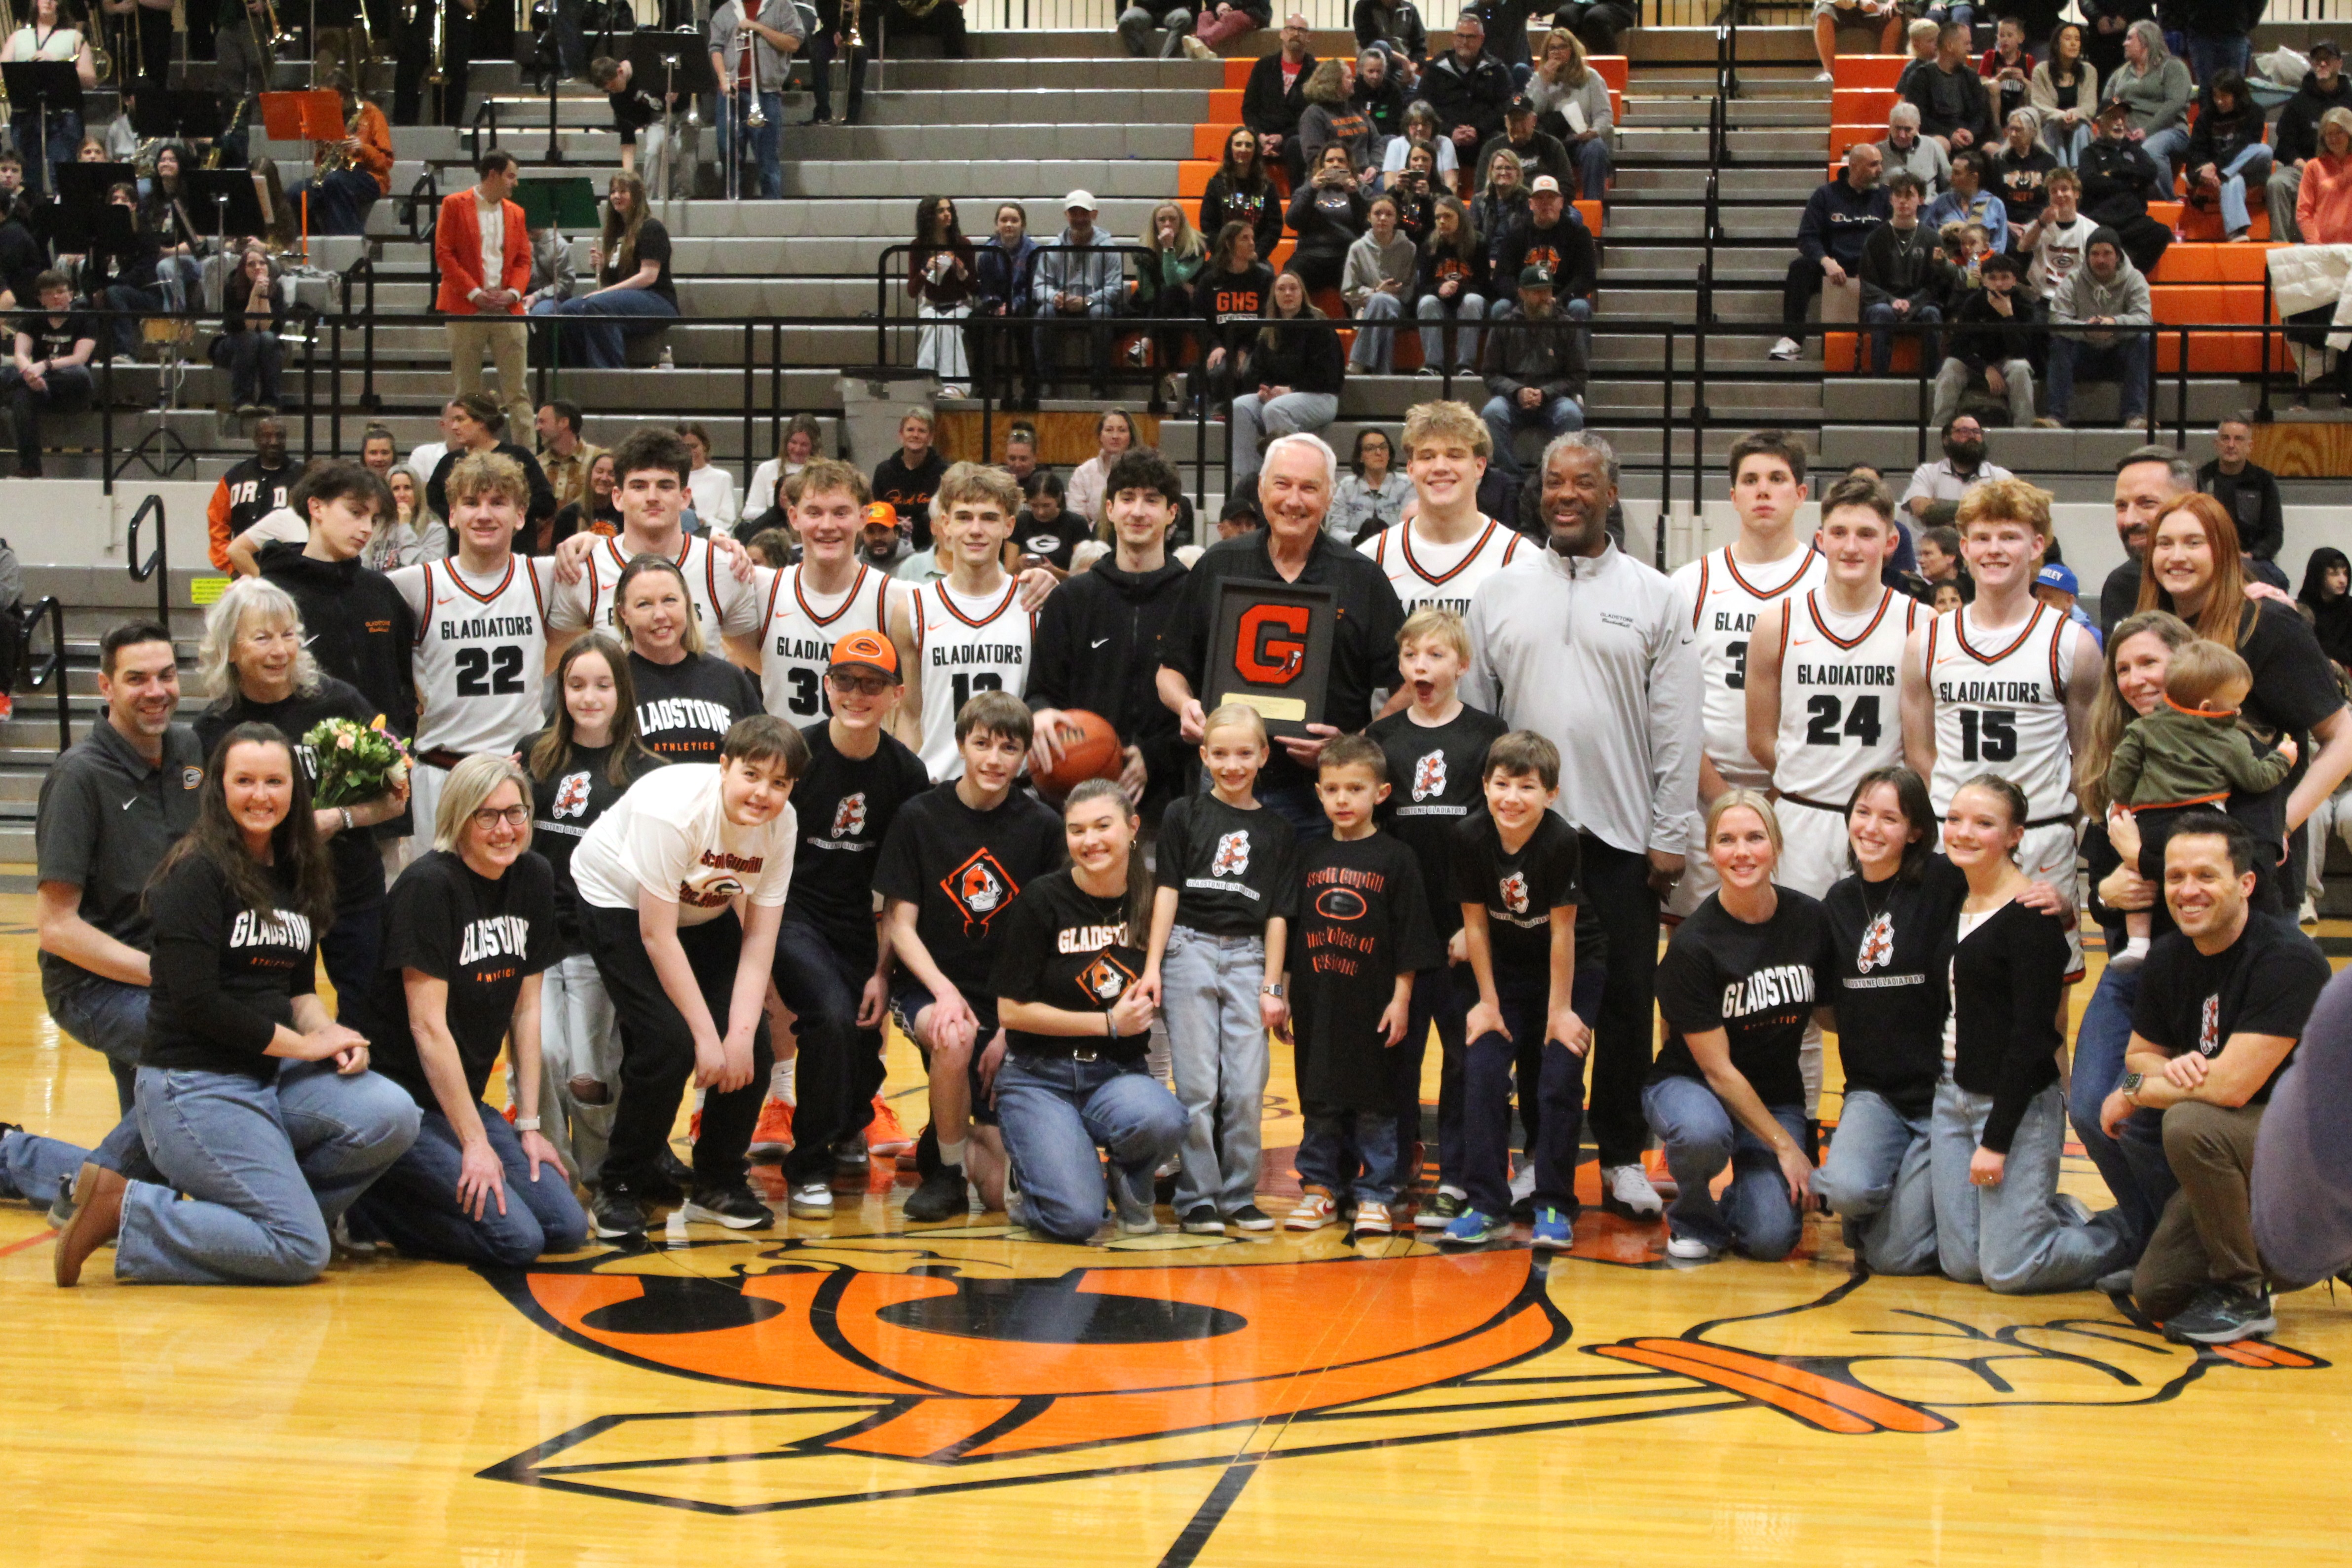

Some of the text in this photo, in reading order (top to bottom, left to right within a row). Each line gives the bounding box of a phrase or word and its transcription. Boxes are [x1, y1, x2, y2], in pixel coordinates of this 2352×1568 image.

[1216, 292, 1258, 311] GHS
[441, 616, 533, 640] GLADIATORS
[1715, 612, 1760, 632] GLAD
[933, 644, 1023, 667] GLADIATORS
[1234, 603, 1310, 686] G
[455, 646, 525, 697] 22
[1798, 664, 1895, 686] GLADIATORS
[1940, 682, 2040, 704] GLADIATORS
[636, 697, 731, 736] LADSTONE
[1807, 695, 1882, 746] 24
[654, 742, 716, 752] ATHLETICS
[1960, 710, 2017, 762] 15
[1427, 805, 1467, 815] GLADIATORS
[1186, 879, 1226, 890] GLADSTONE
[1877, 974, 1925, 987] GLADIATORS
